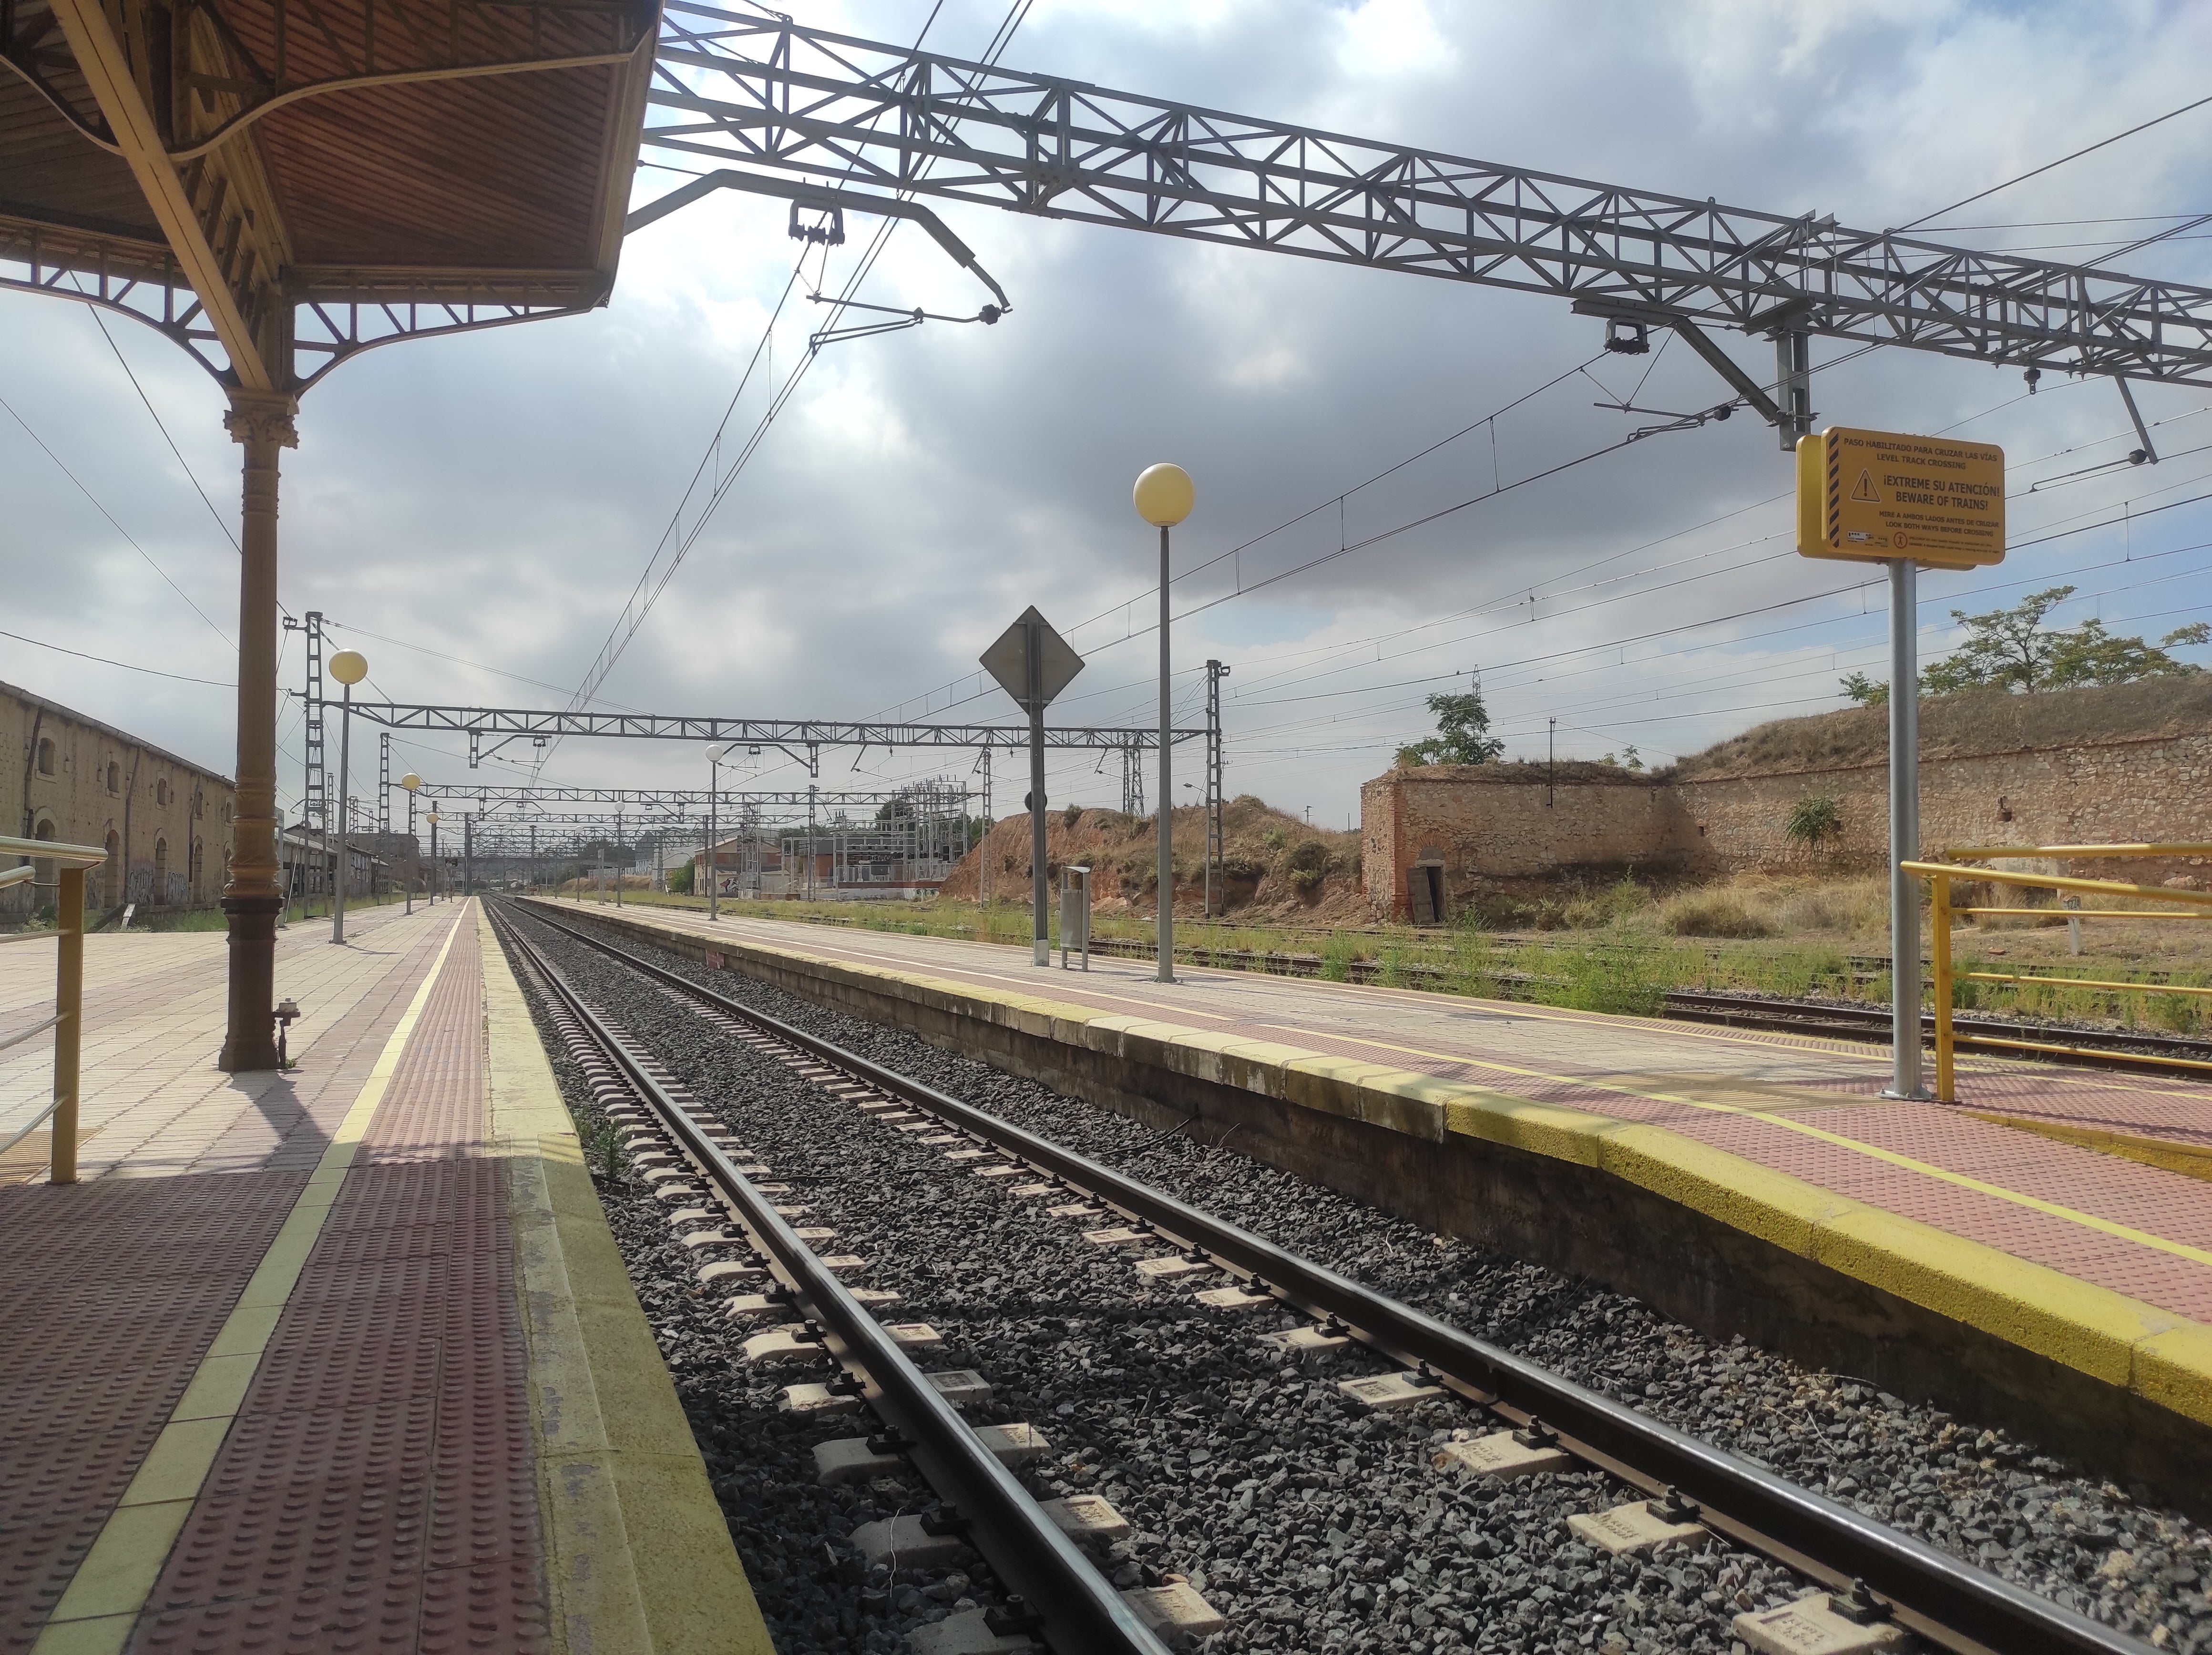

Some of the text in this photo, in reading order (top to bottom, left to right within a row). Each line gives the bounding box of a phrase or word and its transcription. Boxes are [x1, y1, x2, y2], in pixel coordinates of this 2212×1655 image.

[1844, 438, 1997, 461] PASO HABILITADO PARA CRUZAR LAS VÍAS
[1877, 453, 1966, 470] LEVEL TRACK CROSSING
[1884, 475, 1999, 497] ¡EXTREME SU ATENCIÓN!
[1896, 491, 1988, 511] BEWARE OF TRAINS!
[1964, 529, 1993, 537] CROSSING
